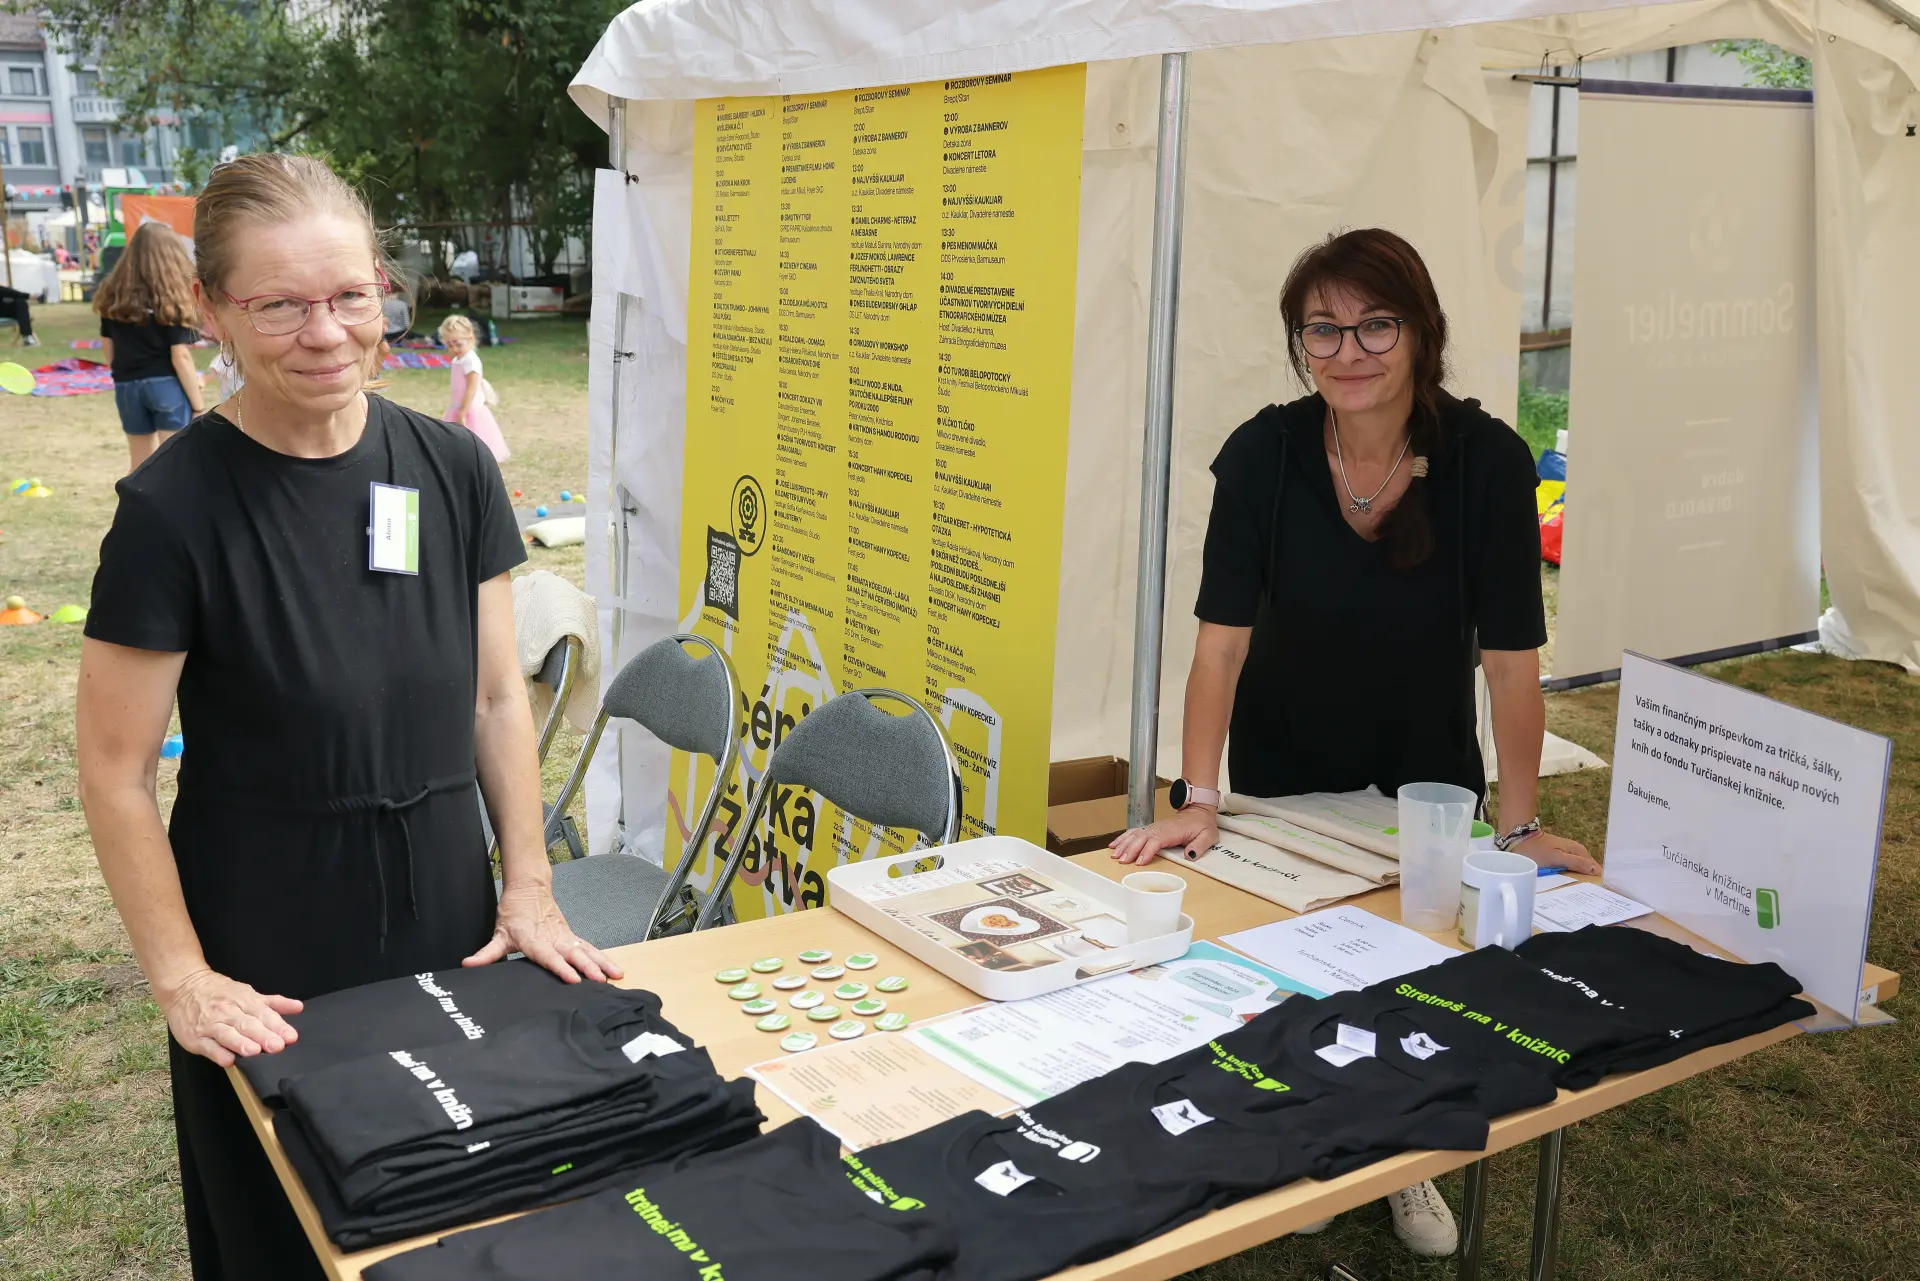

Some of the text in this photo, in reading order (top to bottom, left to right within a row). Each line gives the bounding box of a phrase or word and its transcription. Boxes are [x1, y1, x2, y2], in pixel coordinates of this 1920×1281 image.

[944, 113, 958, 122] 12:00
[854, 123, 865, 131] 12:00
[978, 121, 1008, 132] BANNEROV
[949, 150, 996, 161] KONCERT LETORA
[853, 164, 863, 172] 13:00
[943, 184, 956, 192] 13:00
[957, 242, 977, 250] MENOM
[978, 239, 997, 250] MAČKA
[941, 272, 953, 280] 14:00
[946, 285, 1015, 296] DIVADELNÉ PREDSTAVENIE
[973, 298, 1005, 309] TVORIVÝCH
[940, 310, 1006, 323] ETNOGRAFICKÉHO MÚZEA
[938, 353, 951, 361] 14:30
[944, 364, 950, 374] ČO
[952, 367, 958, 375] TU
[970, 369, 1011, 382] BELOPOTOCKÝ
[937, 405, 949, 414] 15:00
[936, 459, 947, 468] 16:00
[933, 500, 945, 510] 16:30
[932, 524, 951, 537] OTÁZKA
[938, 514, 1011, 541] ETGAR KERET HYPOTETICKÁ
[934, 598, 1000, 628] KONCERT HANY KOPECKEJ
[928, 624, 939, 635] 17:00
[932, 636, 944, 648] ČERT
[929, 689, 995, 726] KONCERT HANY KOPECKEJ
[1635, 695, 1843, 782] Vašim finančným príspevkom za tričká, šálky,
[984, 753, 997, 769] KVÍZ
[1633, 717, 1840, 805] tašky a odznaky prispievate na nákup nových
[972, 762, 990, 779] ŽATVA
[1632, 738, 1785, 810] kníh do fondu Turčianskej knižnice.
[1627, 779, 1671, 810] Ďakujeme.
[966, 814, 996, 836] POKUŠENIE
[1221, 849, 1241, 860] ma
[1662, 844, 1751, 899] Turčianska knižnica
[1706, 886, 1750, 916] v Martine
[1571, 980, 1599, 999] ma
[1395, 983, 1571, 1065] Stretneš ma v knižnic
[1209, 1041, 1227, 1057] ska
[427, 1079, 445, 1088] v
[690, 1249, 710, 1262] v
